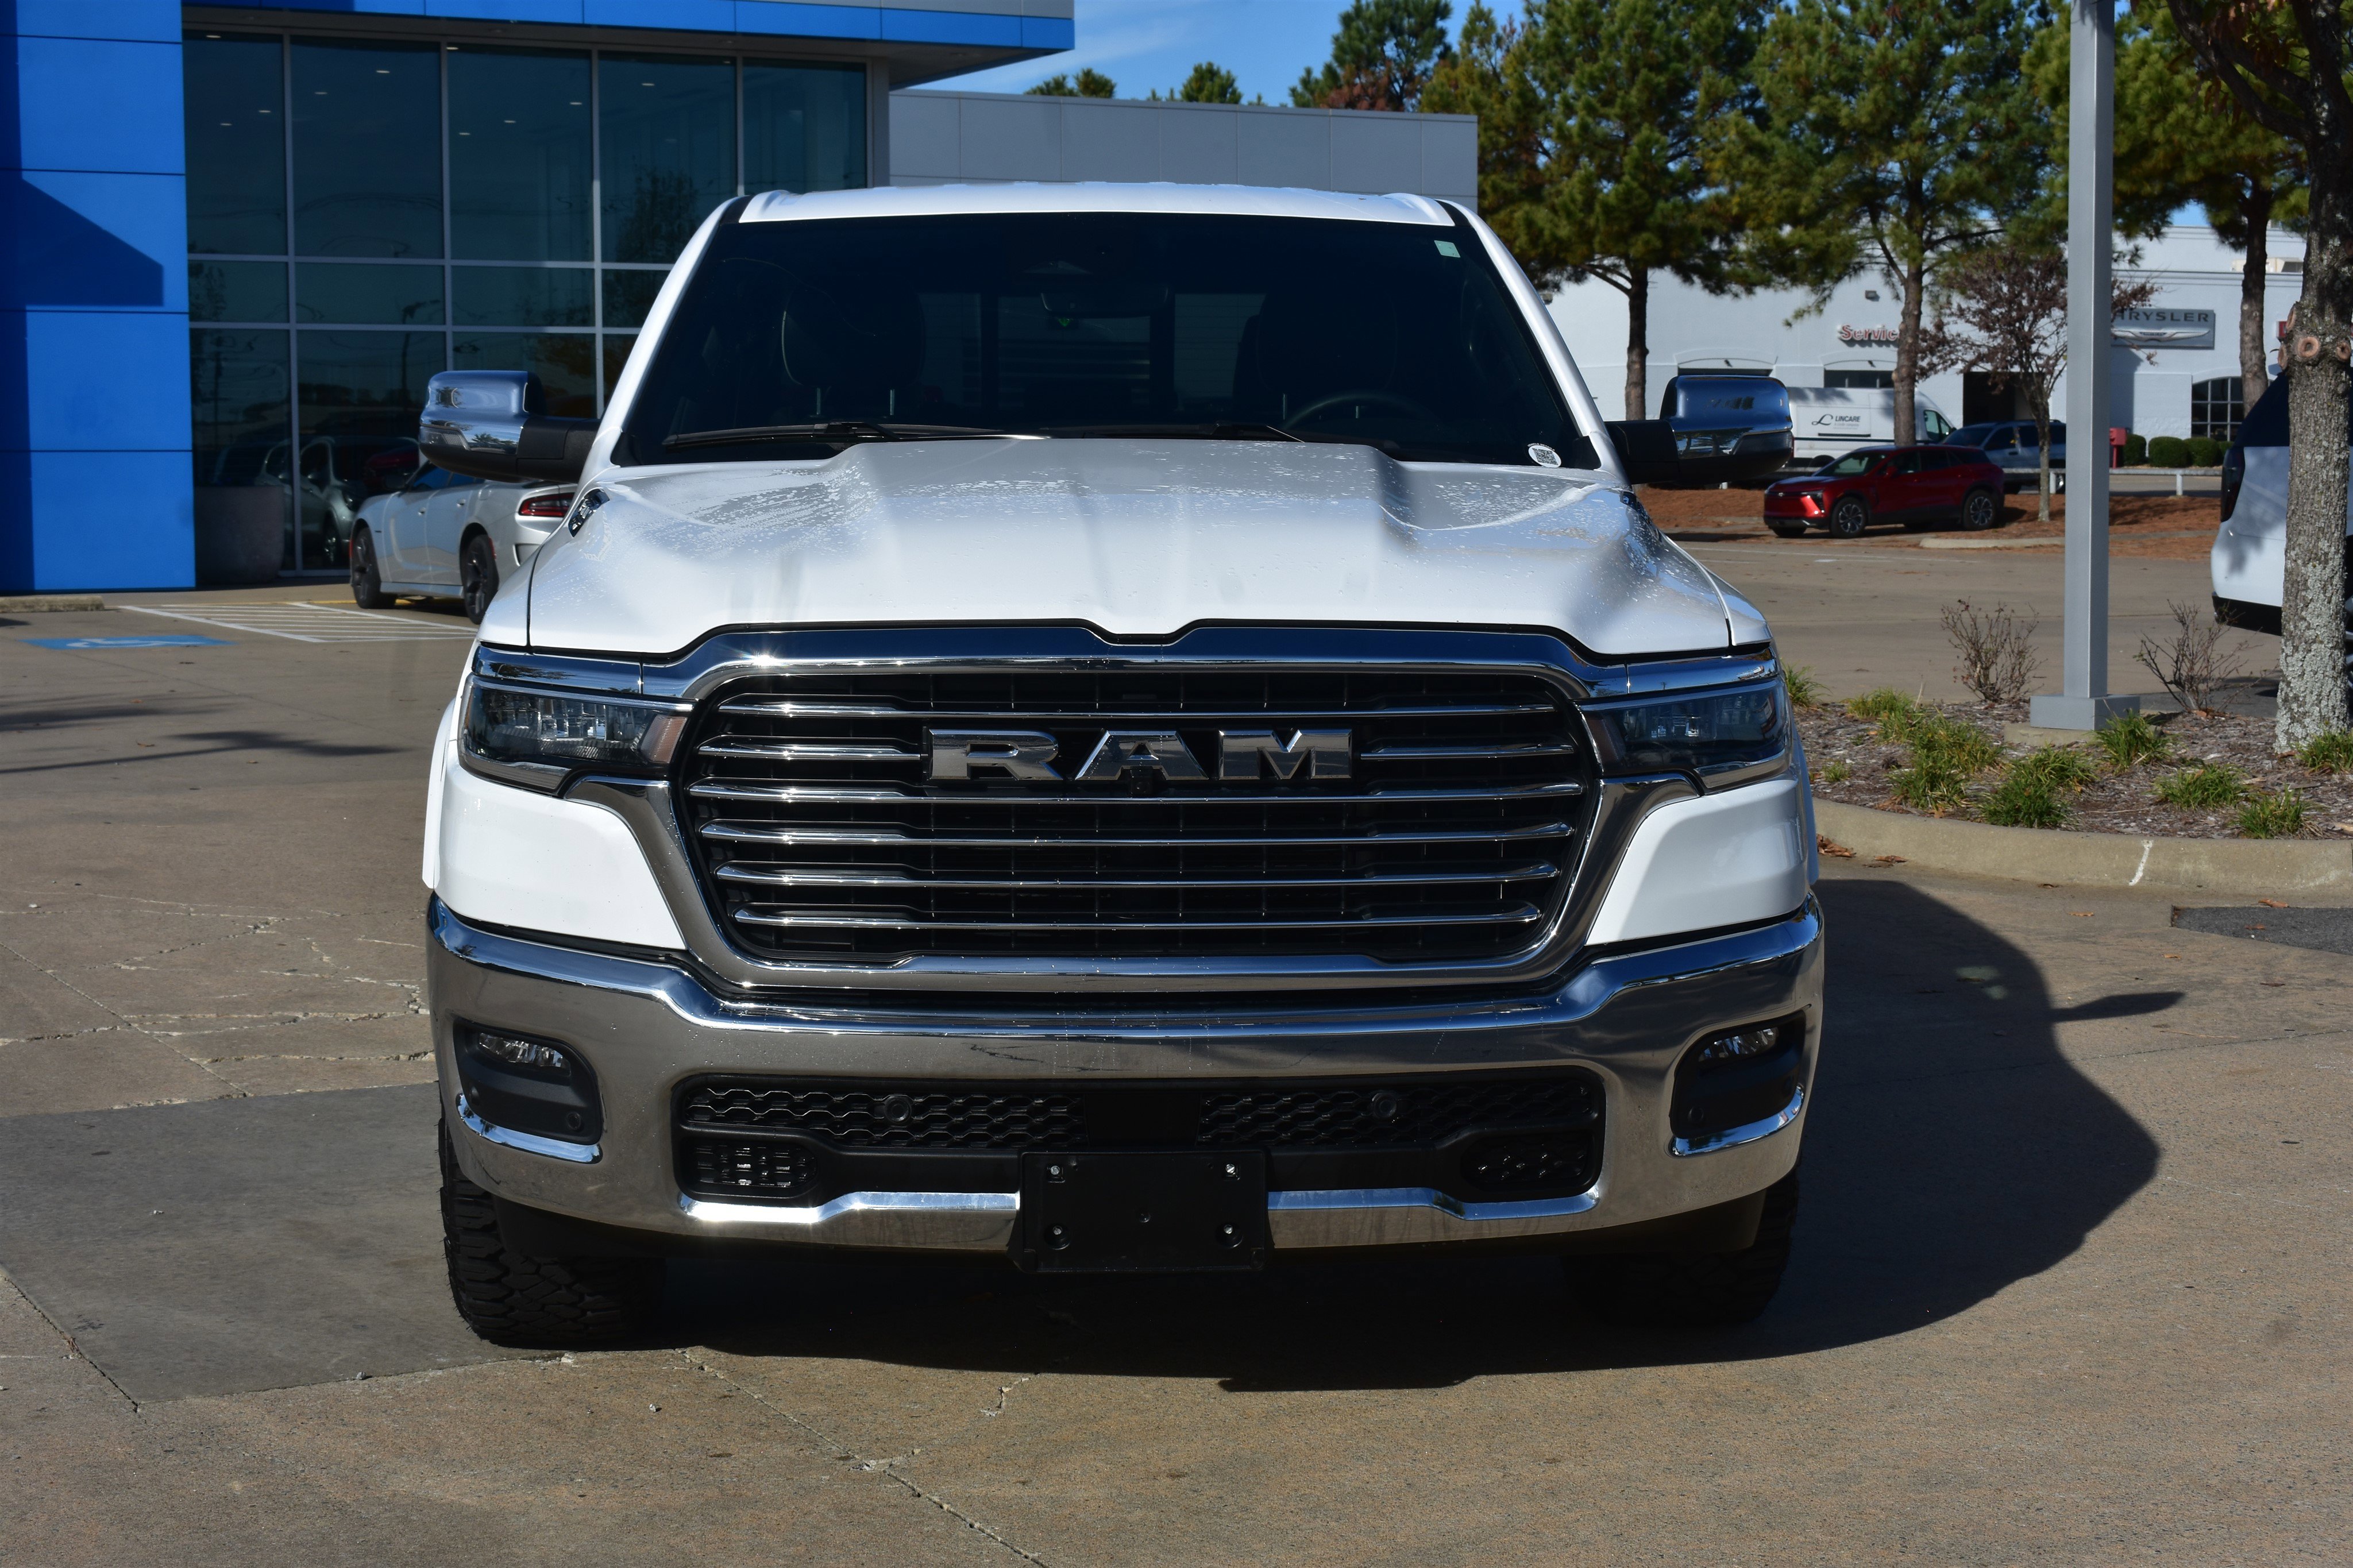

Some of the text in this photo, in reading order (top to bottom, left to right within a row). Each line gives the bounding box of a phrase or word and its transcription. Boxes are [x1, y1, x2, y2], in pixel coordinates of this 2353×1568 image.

[2113, 311, 2209, 322] HRYSLER
[1840, 325, 1900, 341] Servic
[928, 729, 1352, 781] RAM
